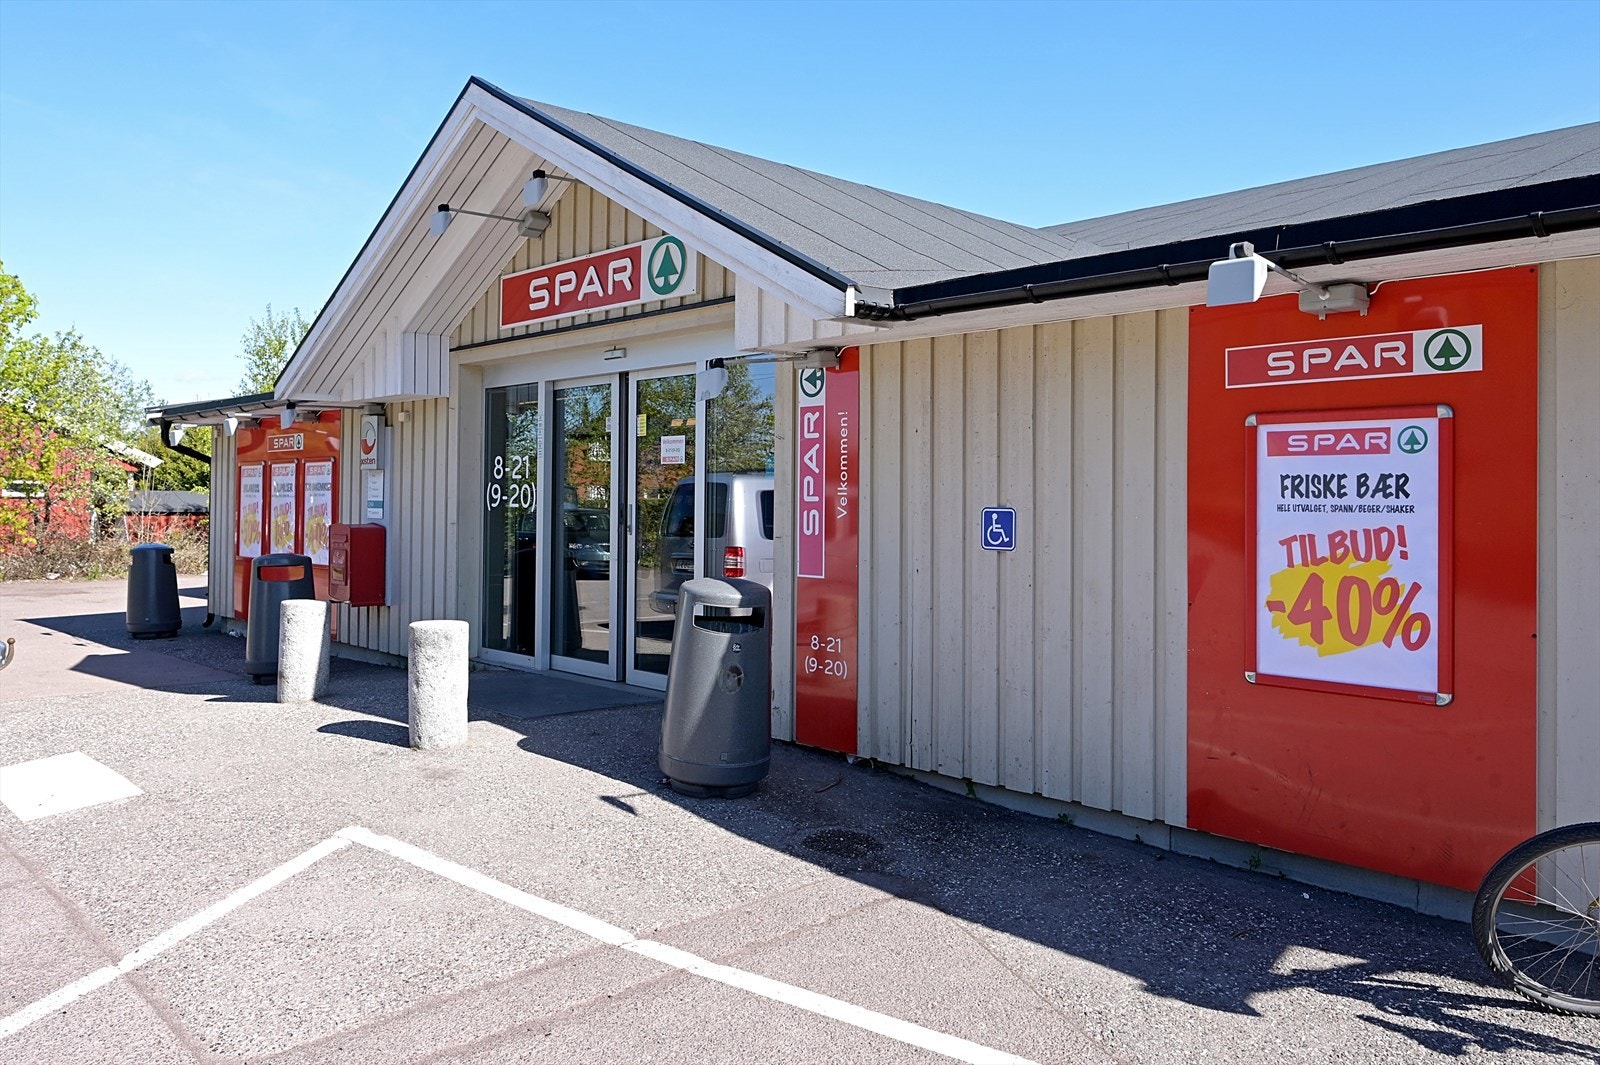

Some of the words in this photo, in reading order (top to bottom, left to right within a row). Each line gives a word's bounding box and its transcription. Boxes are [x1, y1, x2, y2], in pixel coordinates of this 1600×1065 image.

[528, 257, 633, 311] SPAR
[1266, 340, 1407, 377] SPAR
[273, 438, 294, 449] SPAR
[1287, 432, 1388, 452] SPAR
[360, 456, 376, 465] osten
[493, 455, 530, 480] 8-21
[803, 411, 820, 536] SPAR
[836, 411, 848, 519] Velkommen!
[486, 482, 537, 513] (9-20)
[1279, 473, 1349, 500] FRISKE
[1356, 473, 1411, 500] BÆR
[1277, 504, 1291, 513] HELE
[1292, 504, 1329, 514] UTVALGET,
[1330, 504, 1415, 514] SPANN/BEGER/SHAKER
[1279, 525, 1409, 569] TILBUD!
[1266, 572, 1431, 651] -40%
[811, 635, 841, 653] 8-21
[805, 655, 848, 680] (9-20)
